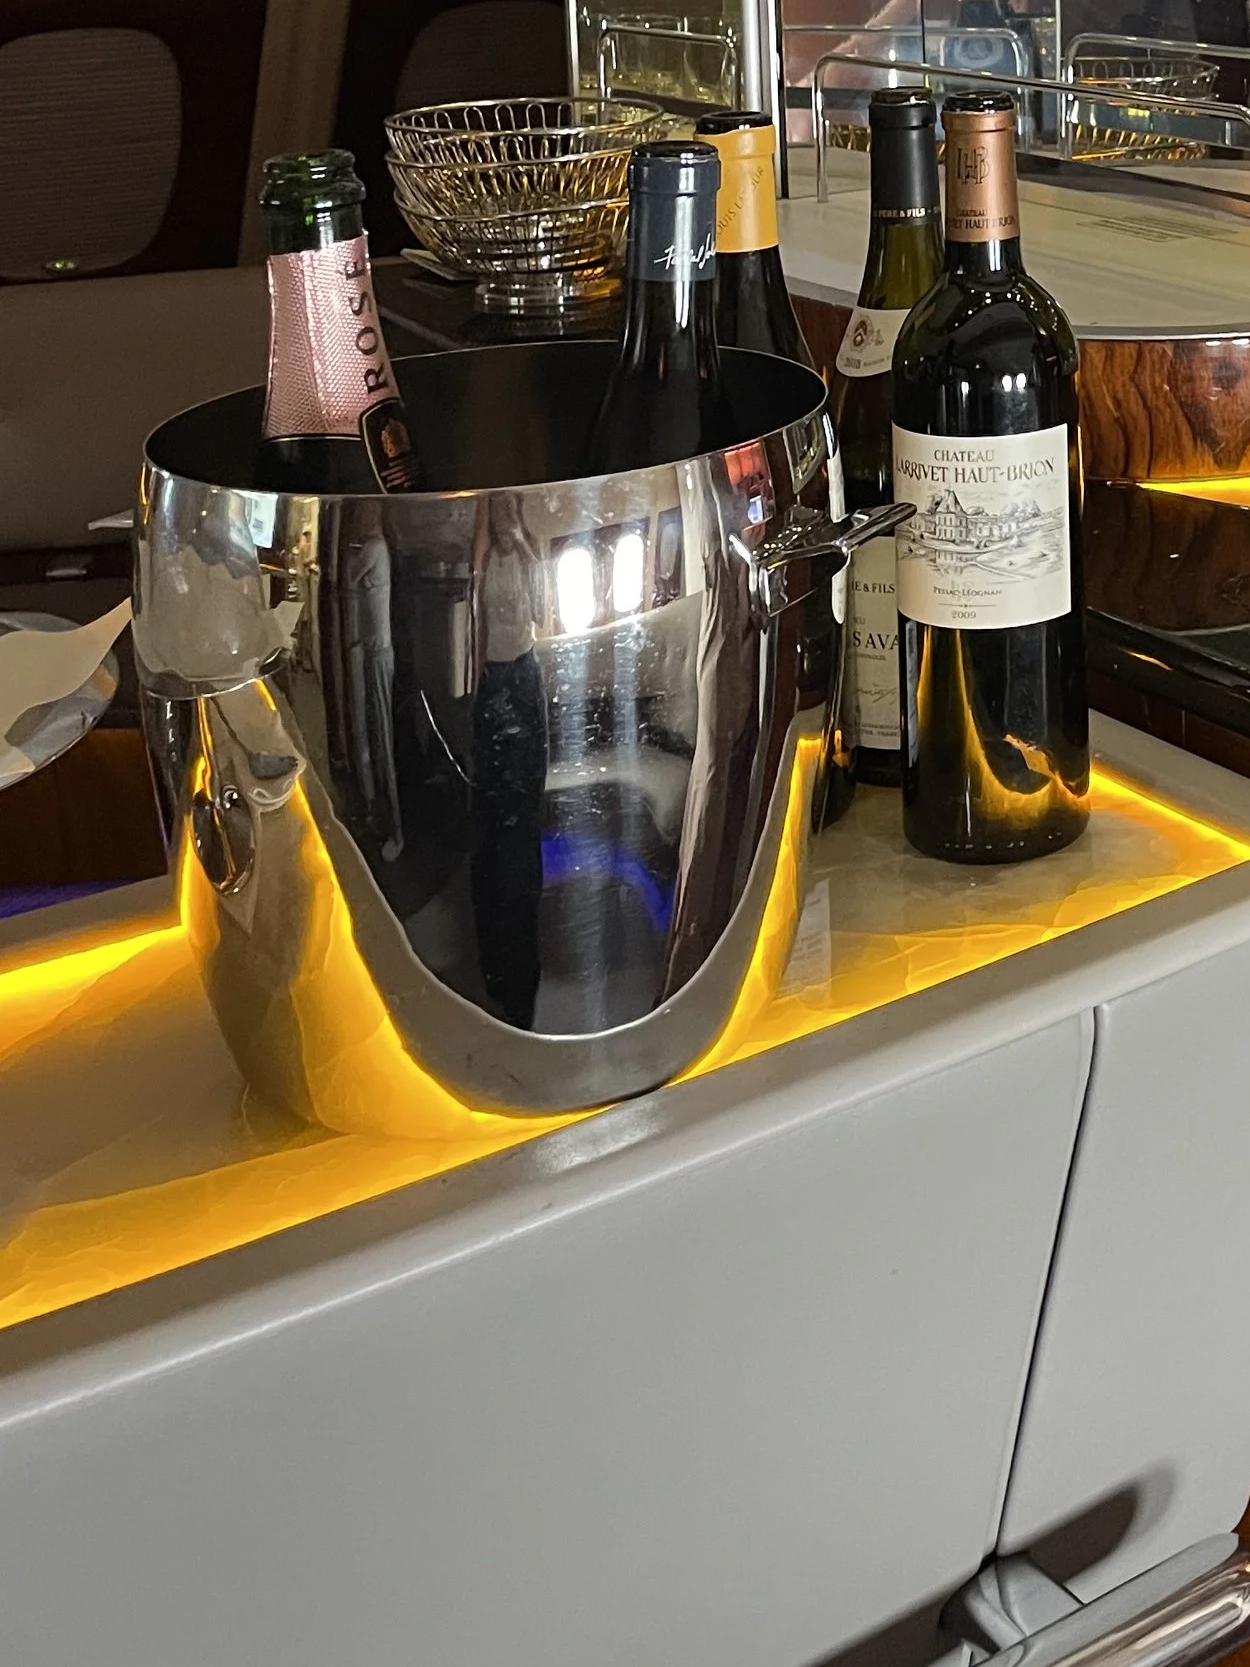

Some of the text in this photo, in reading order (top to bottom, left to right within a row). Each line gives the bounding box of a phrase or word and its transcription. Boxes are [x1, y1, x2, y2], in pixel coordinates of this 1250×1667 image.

[907, 207, 926, 218] FILS
[954, 457, 1056, 484] HAUT-BRION
[863, 582, 870, 593] &
[872, 583, 896, 595] FILS
[951, 610, 977, 620] 2009
